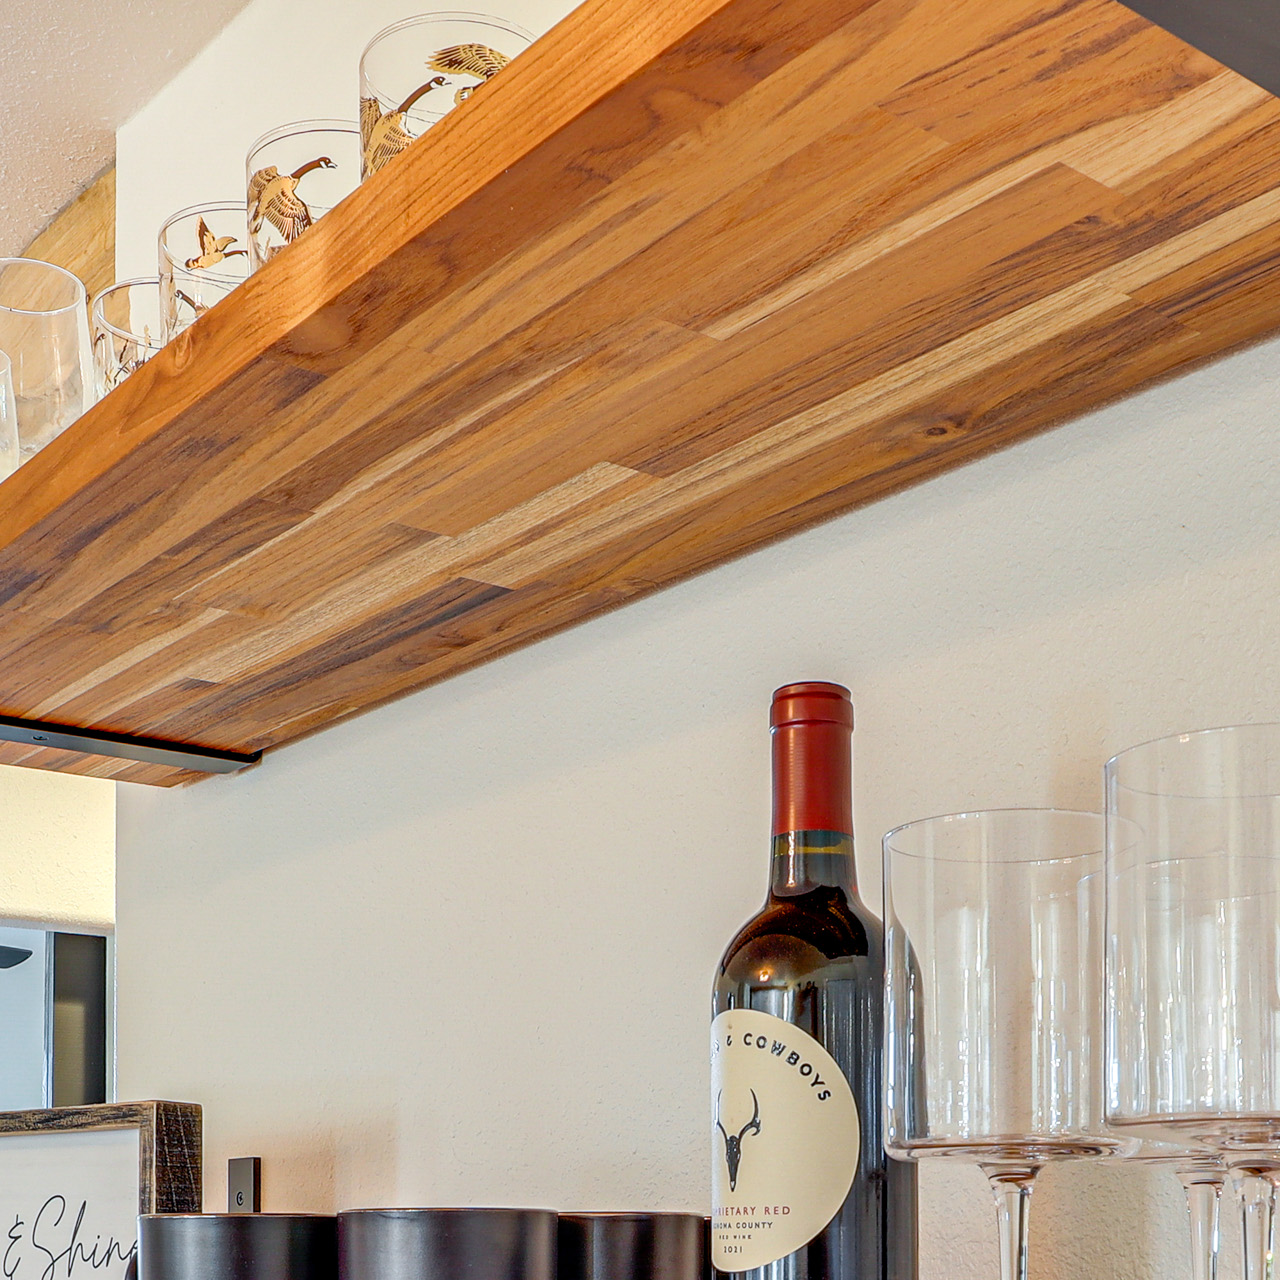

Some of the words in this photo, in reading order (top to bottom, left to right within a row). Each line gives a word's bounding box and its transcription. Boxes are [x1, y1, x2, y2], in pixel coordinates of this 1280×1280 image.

[743, 1032, 832, 1101] COWBOYS
[764, 1206, 791, 1215] RED
[723, 1245, 743, 1254] 2021
